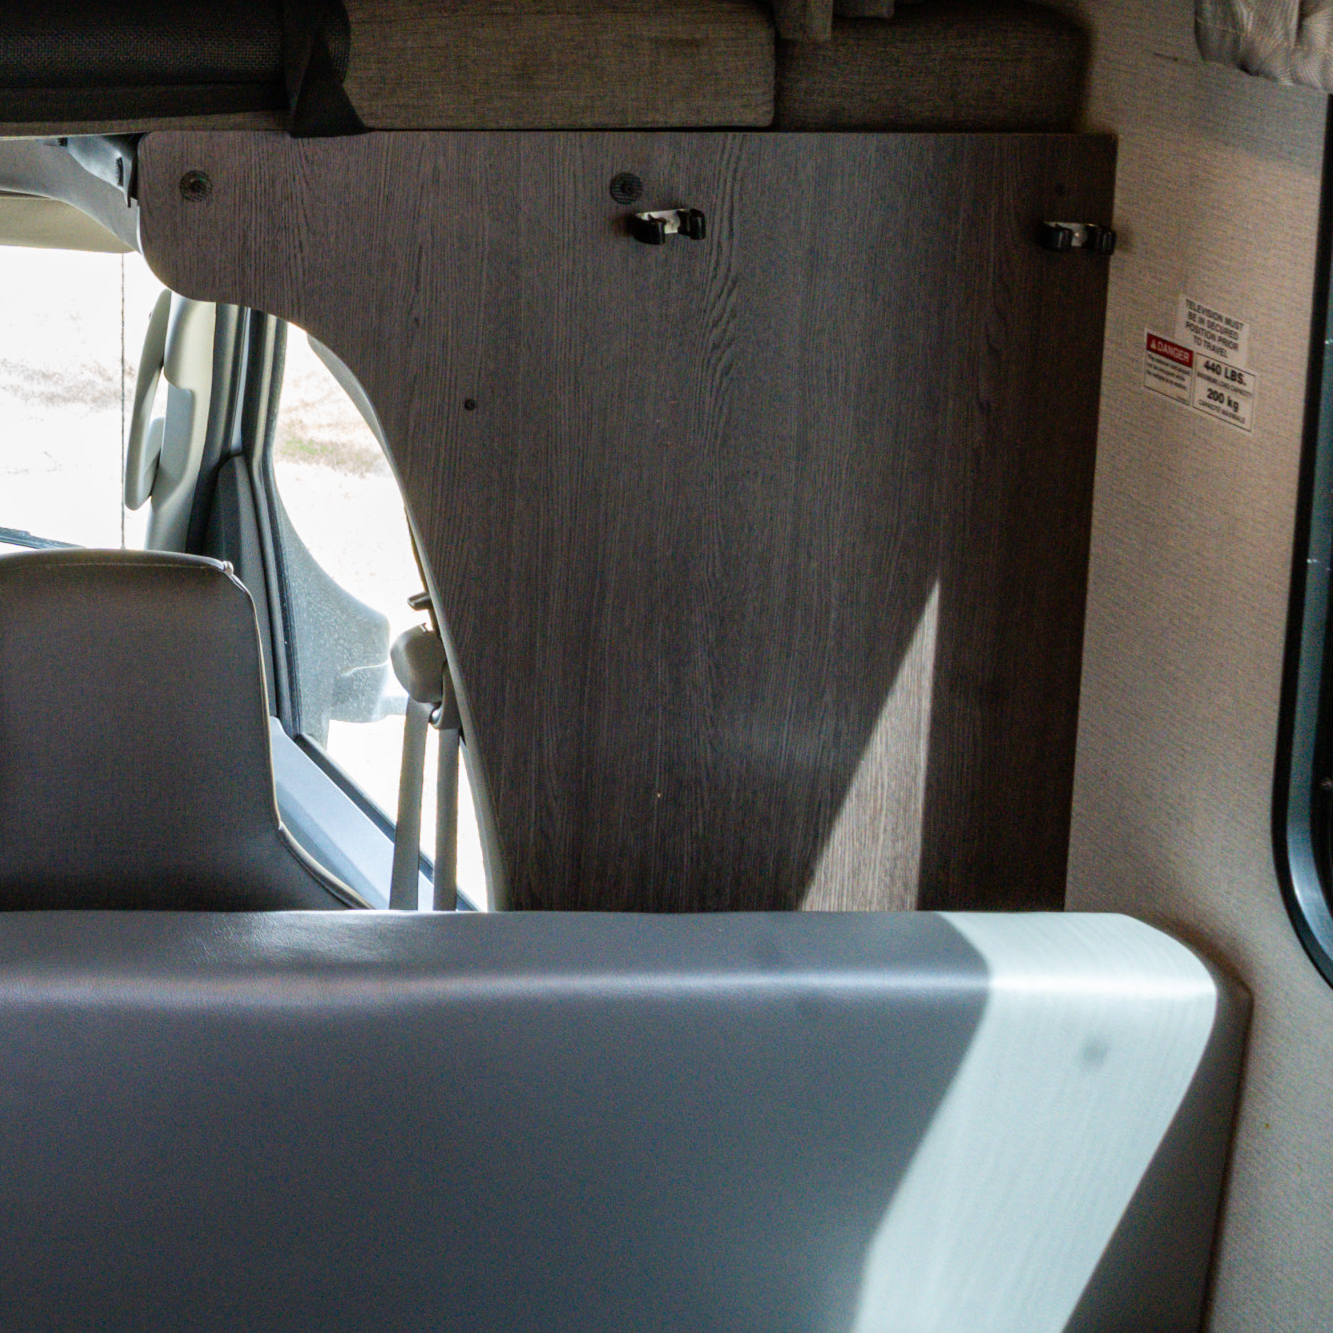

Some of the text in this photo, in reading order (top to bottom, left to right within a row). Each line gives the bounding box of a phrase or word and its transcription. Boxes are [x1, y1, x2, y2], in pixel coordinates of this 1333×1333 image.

[1186, 298, 1244, 331] TELEVISION MUST
[1188, 311, 1238, 341] BE IN SECURED
[1186, 321, 1239, 352] POSITION PRIOR
[1193, 334, 1227, 358] TO TRAVEL
[1157, 341, 1190, 364] DANGER
[1204, 360, 1222, 376] 440
[1224, 367, 1247, 386] LBS.
[1207, 388, 1225, 404] 200
[1227, 395, 1239, 413] kg
